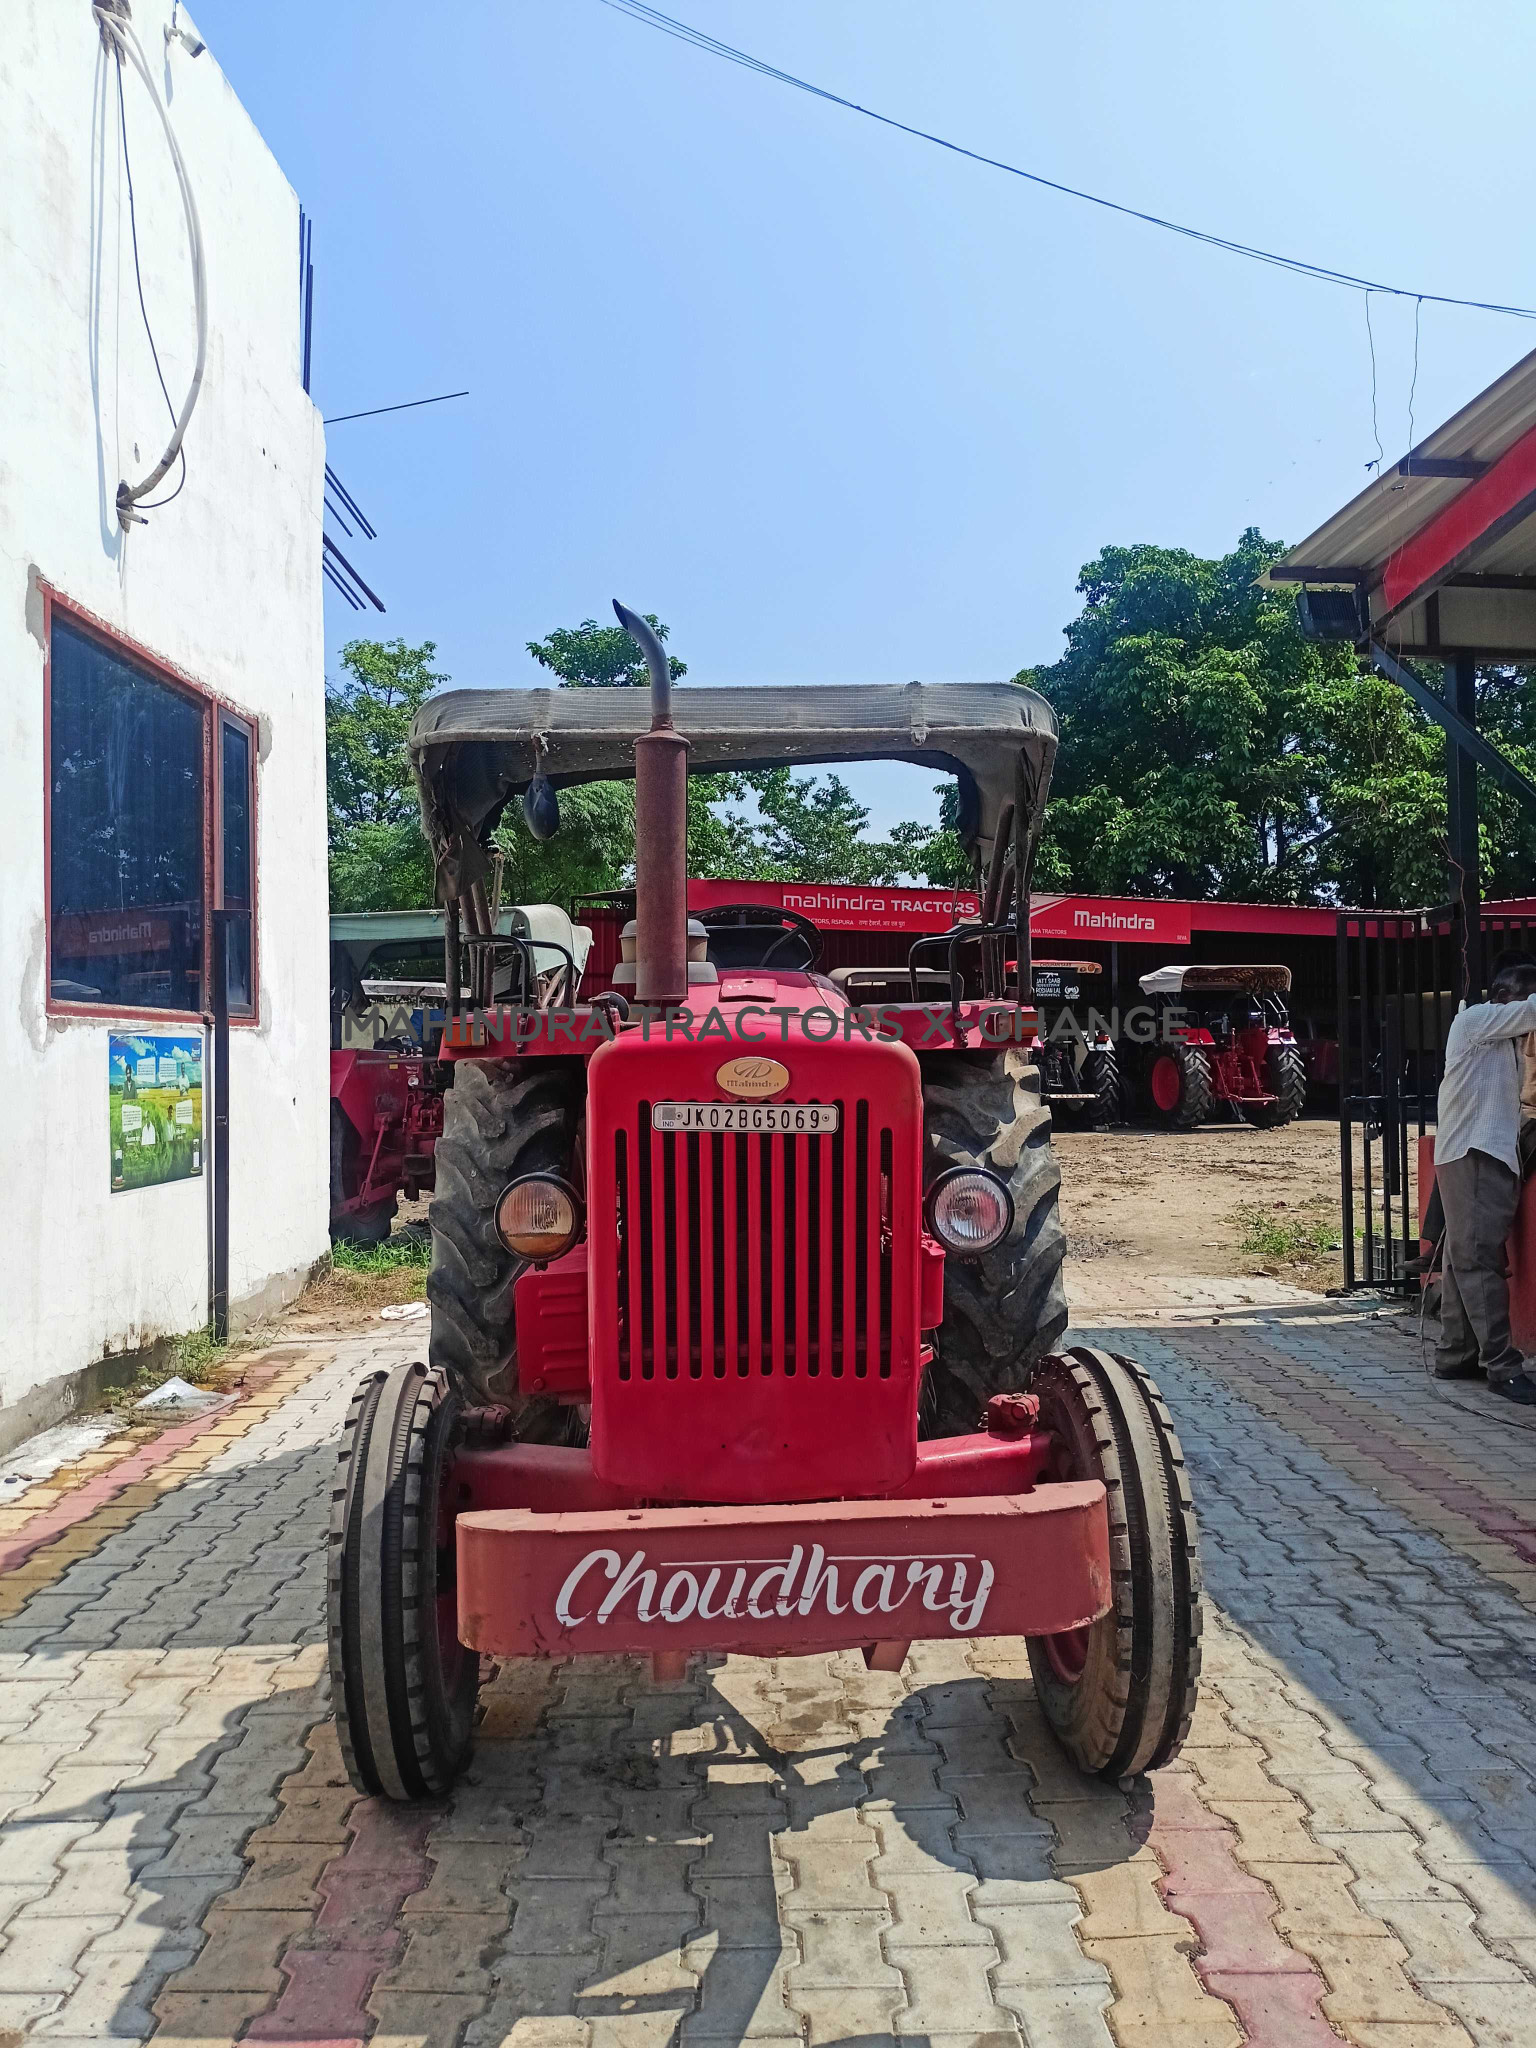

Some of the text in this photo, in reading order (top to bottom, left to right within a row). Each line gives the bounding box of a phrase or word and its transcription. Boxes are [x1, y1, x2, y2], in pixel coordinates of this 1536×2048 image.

[890, 899, 976, 914] TRACTORS
[682, 1107, 820, 1128] JK02BG5069
[555, 1543, 995, 1631] Choudhary
